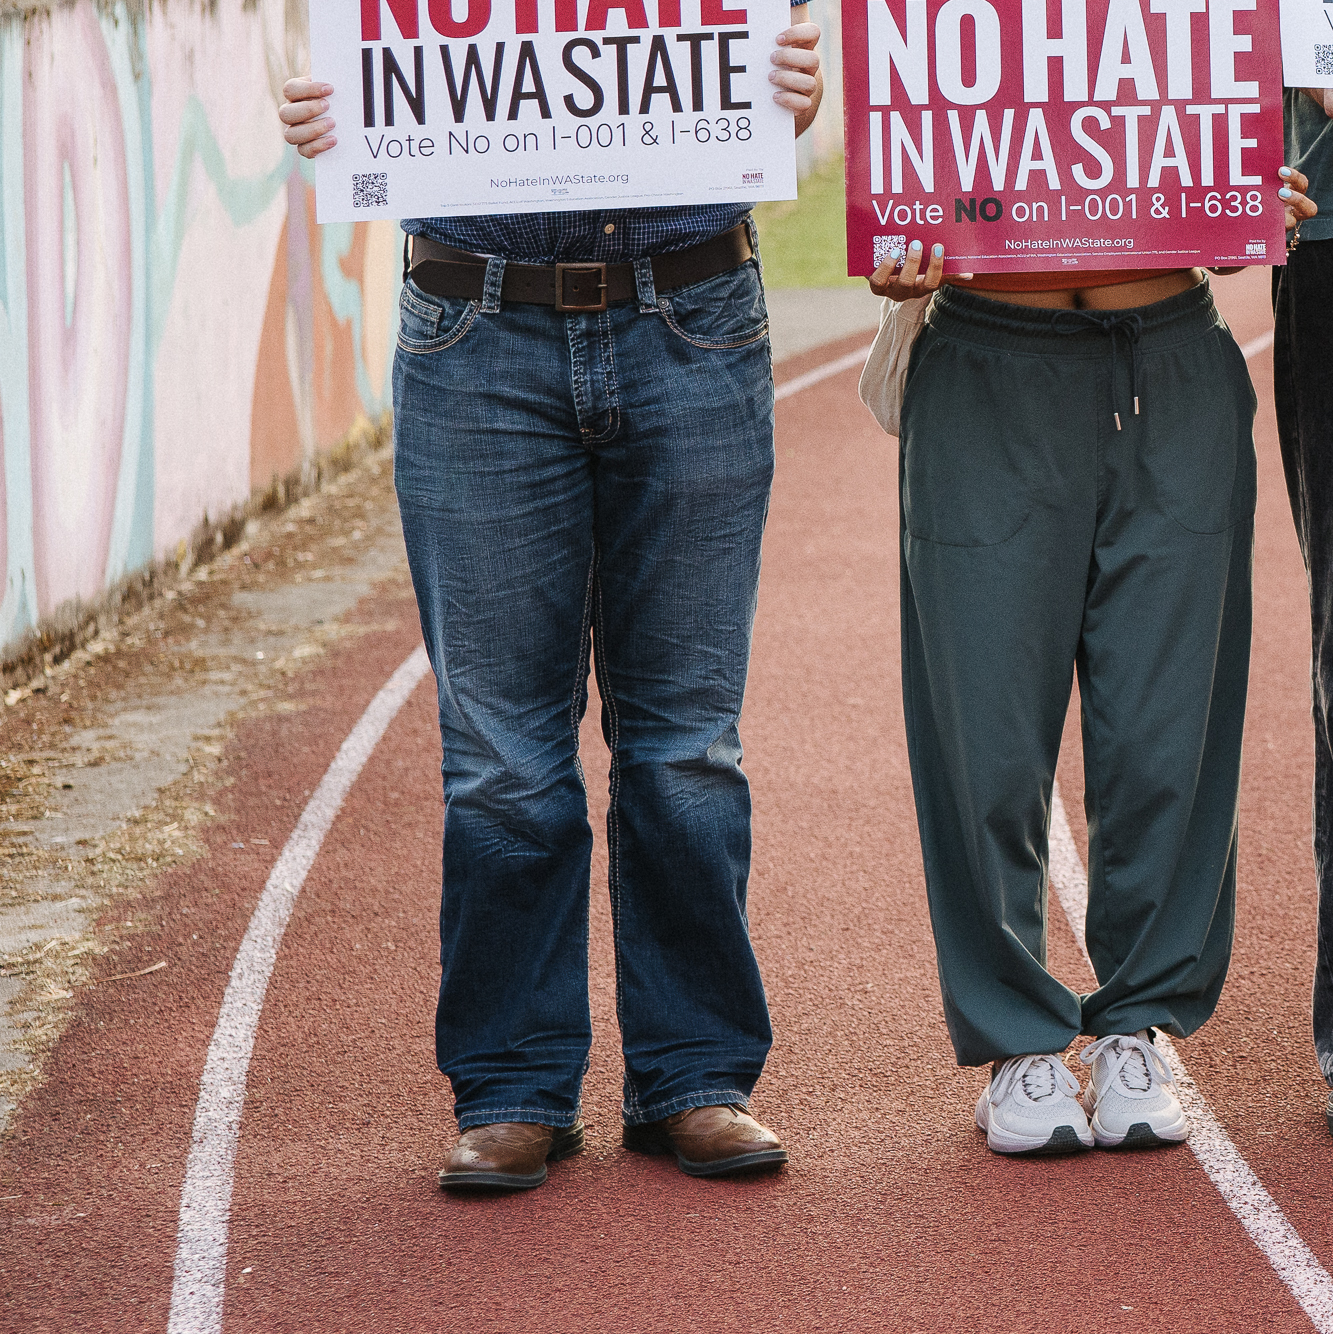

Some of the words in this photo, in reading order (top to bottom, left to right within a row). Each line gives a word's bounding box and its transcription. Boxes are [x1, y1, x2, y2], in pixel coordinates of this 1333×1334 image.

[361, 46, 425, 128] IN
[439, 41, 552, 123] WA
[562, 31, 752, 118] STATE
[364, 133, 435, 159] Vote
[448, 130, 490, 155] No
[503, 131, 538, 152] on
[552, 123, 626, 150] I-001
[641, 122, 659, 145] &
[671, 117, 752, 145] I-638
[869, 110, 934, 194] IN
[947, 108, 1061, 191] WA
[1071, 104, 1262, 189] STATE
[490, 172, 629, 189] NoHateInWAState.org
[872, 199, 943, 226] Vote
[955, 197, 1003, 222] NO
[1012, 201, 1048, 222] on
[1061, 194, 1136, 220] I-001
[1150, 193, 1169, 218] &
[1181, 191, 1263, 217] I-638
[1006, 237, 1134, 251] NoHateInWAState.org
